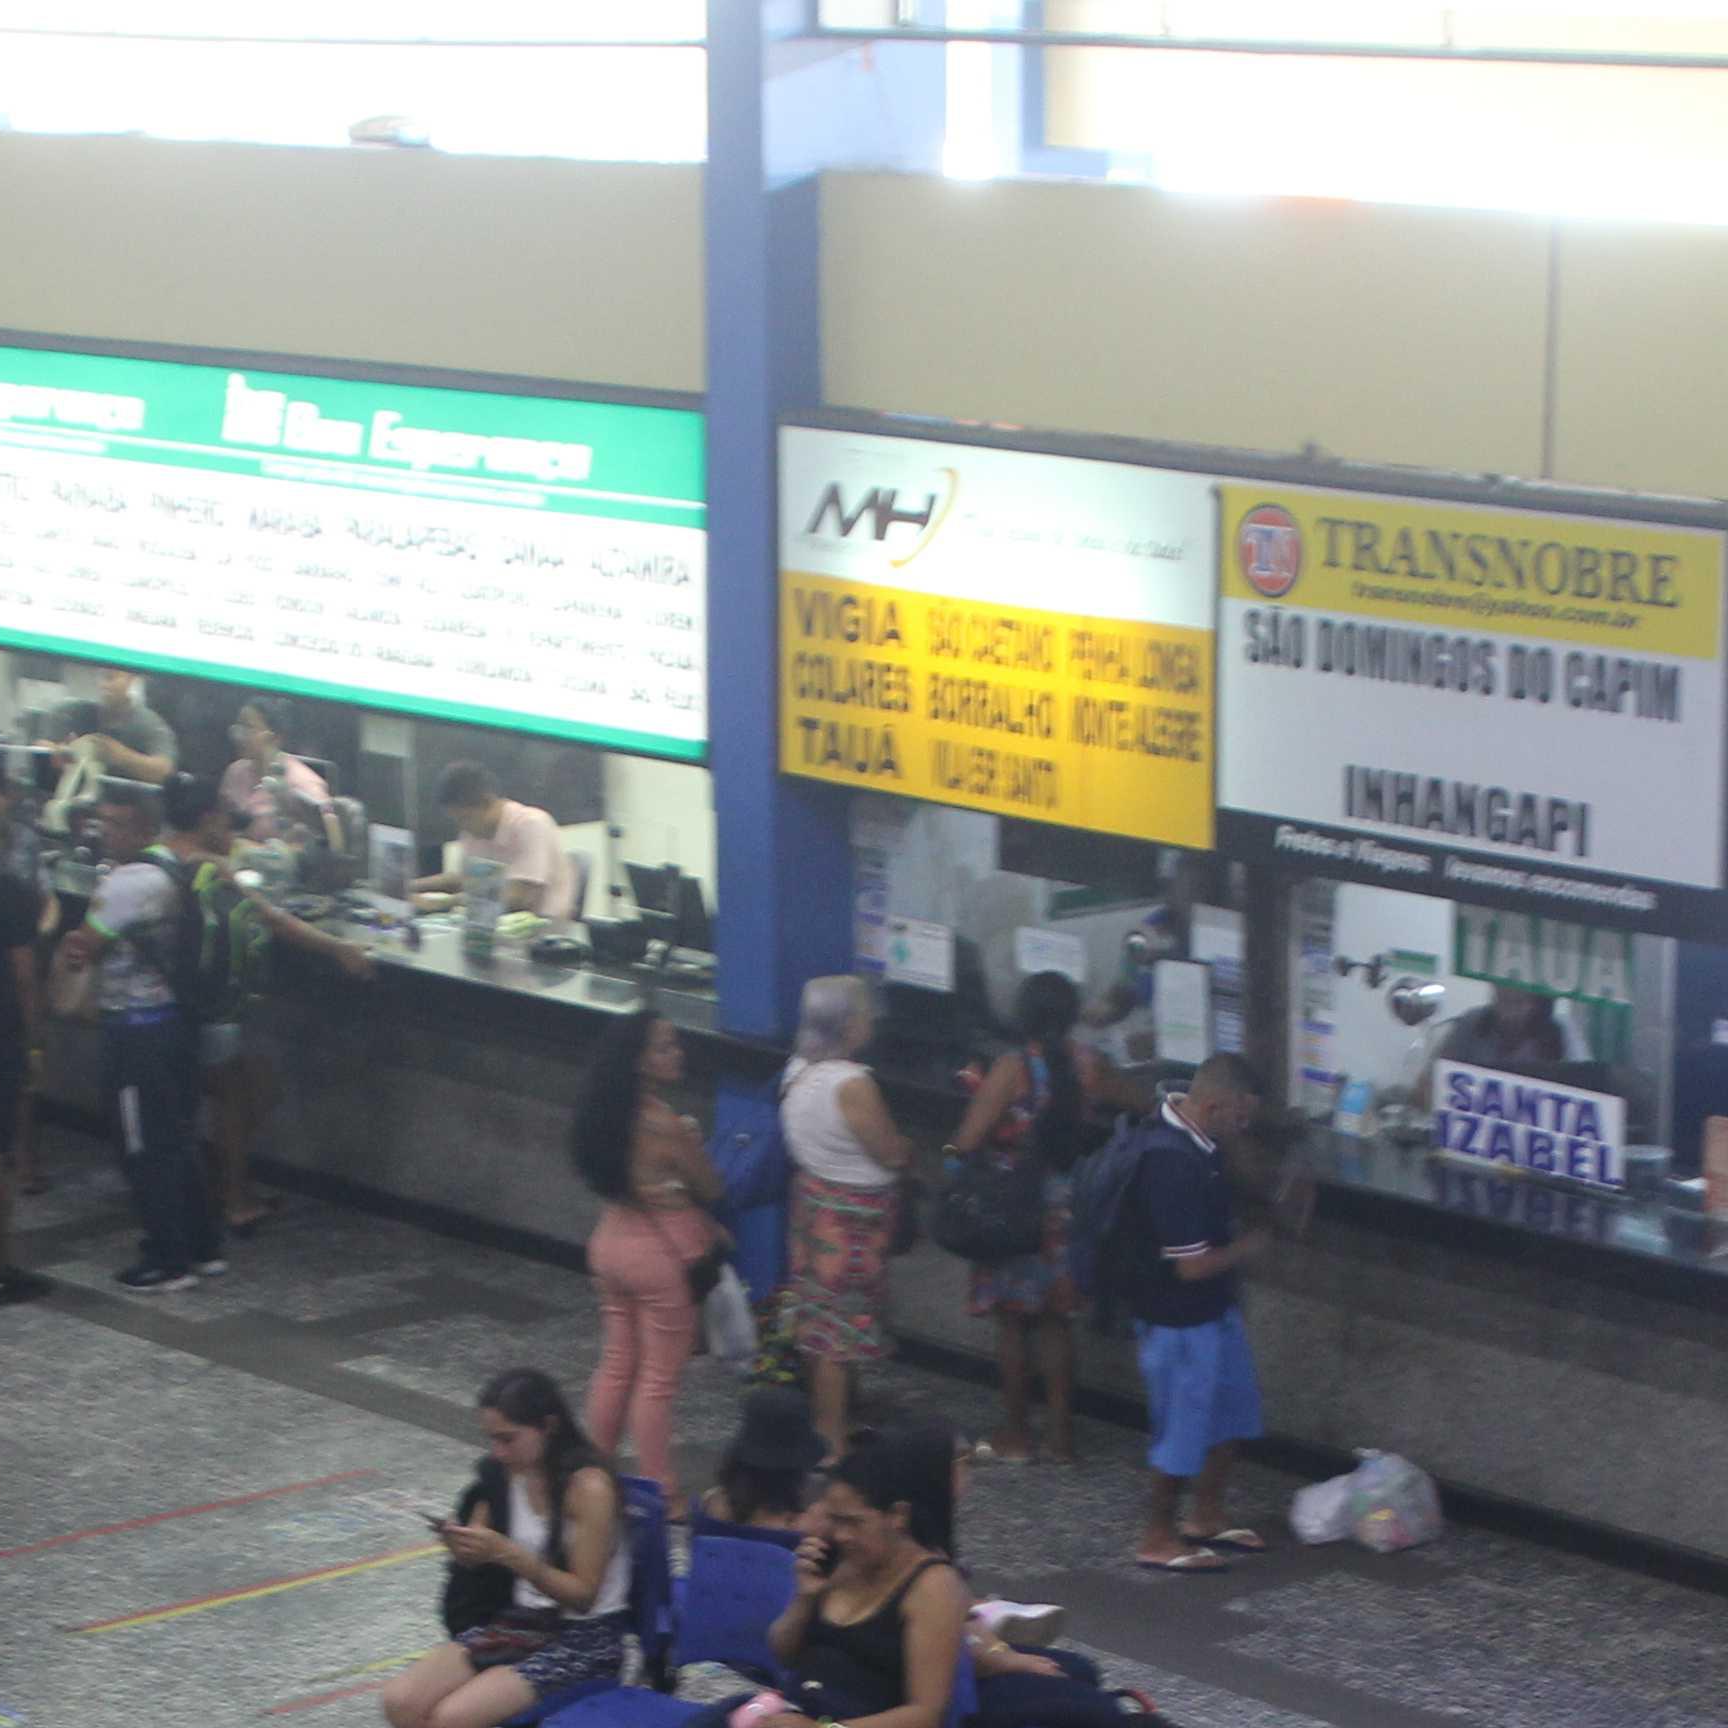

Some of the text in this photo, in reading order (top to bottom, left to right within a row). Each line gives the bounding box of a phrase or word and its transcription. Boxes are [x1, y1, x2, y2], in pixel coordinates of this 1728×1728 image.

[805, 480, 937, 541] MH
[1314, 516, 1681, 609] TRANSNOBRE
[792, 586, 906, 648] VIGIA
[793, 649, 912, 714] COLARES
[1243, 606, 1682, 724] SÃO DOMINGOS DO CAPIM
[796, 713, 905, 779] TAUÁ
[1343, 763, 1591, 858] INHANGAPI
[1447, 1070, 1603, 1141] SANTA
[1435, 1107, 1623, 1187] IZABEL
